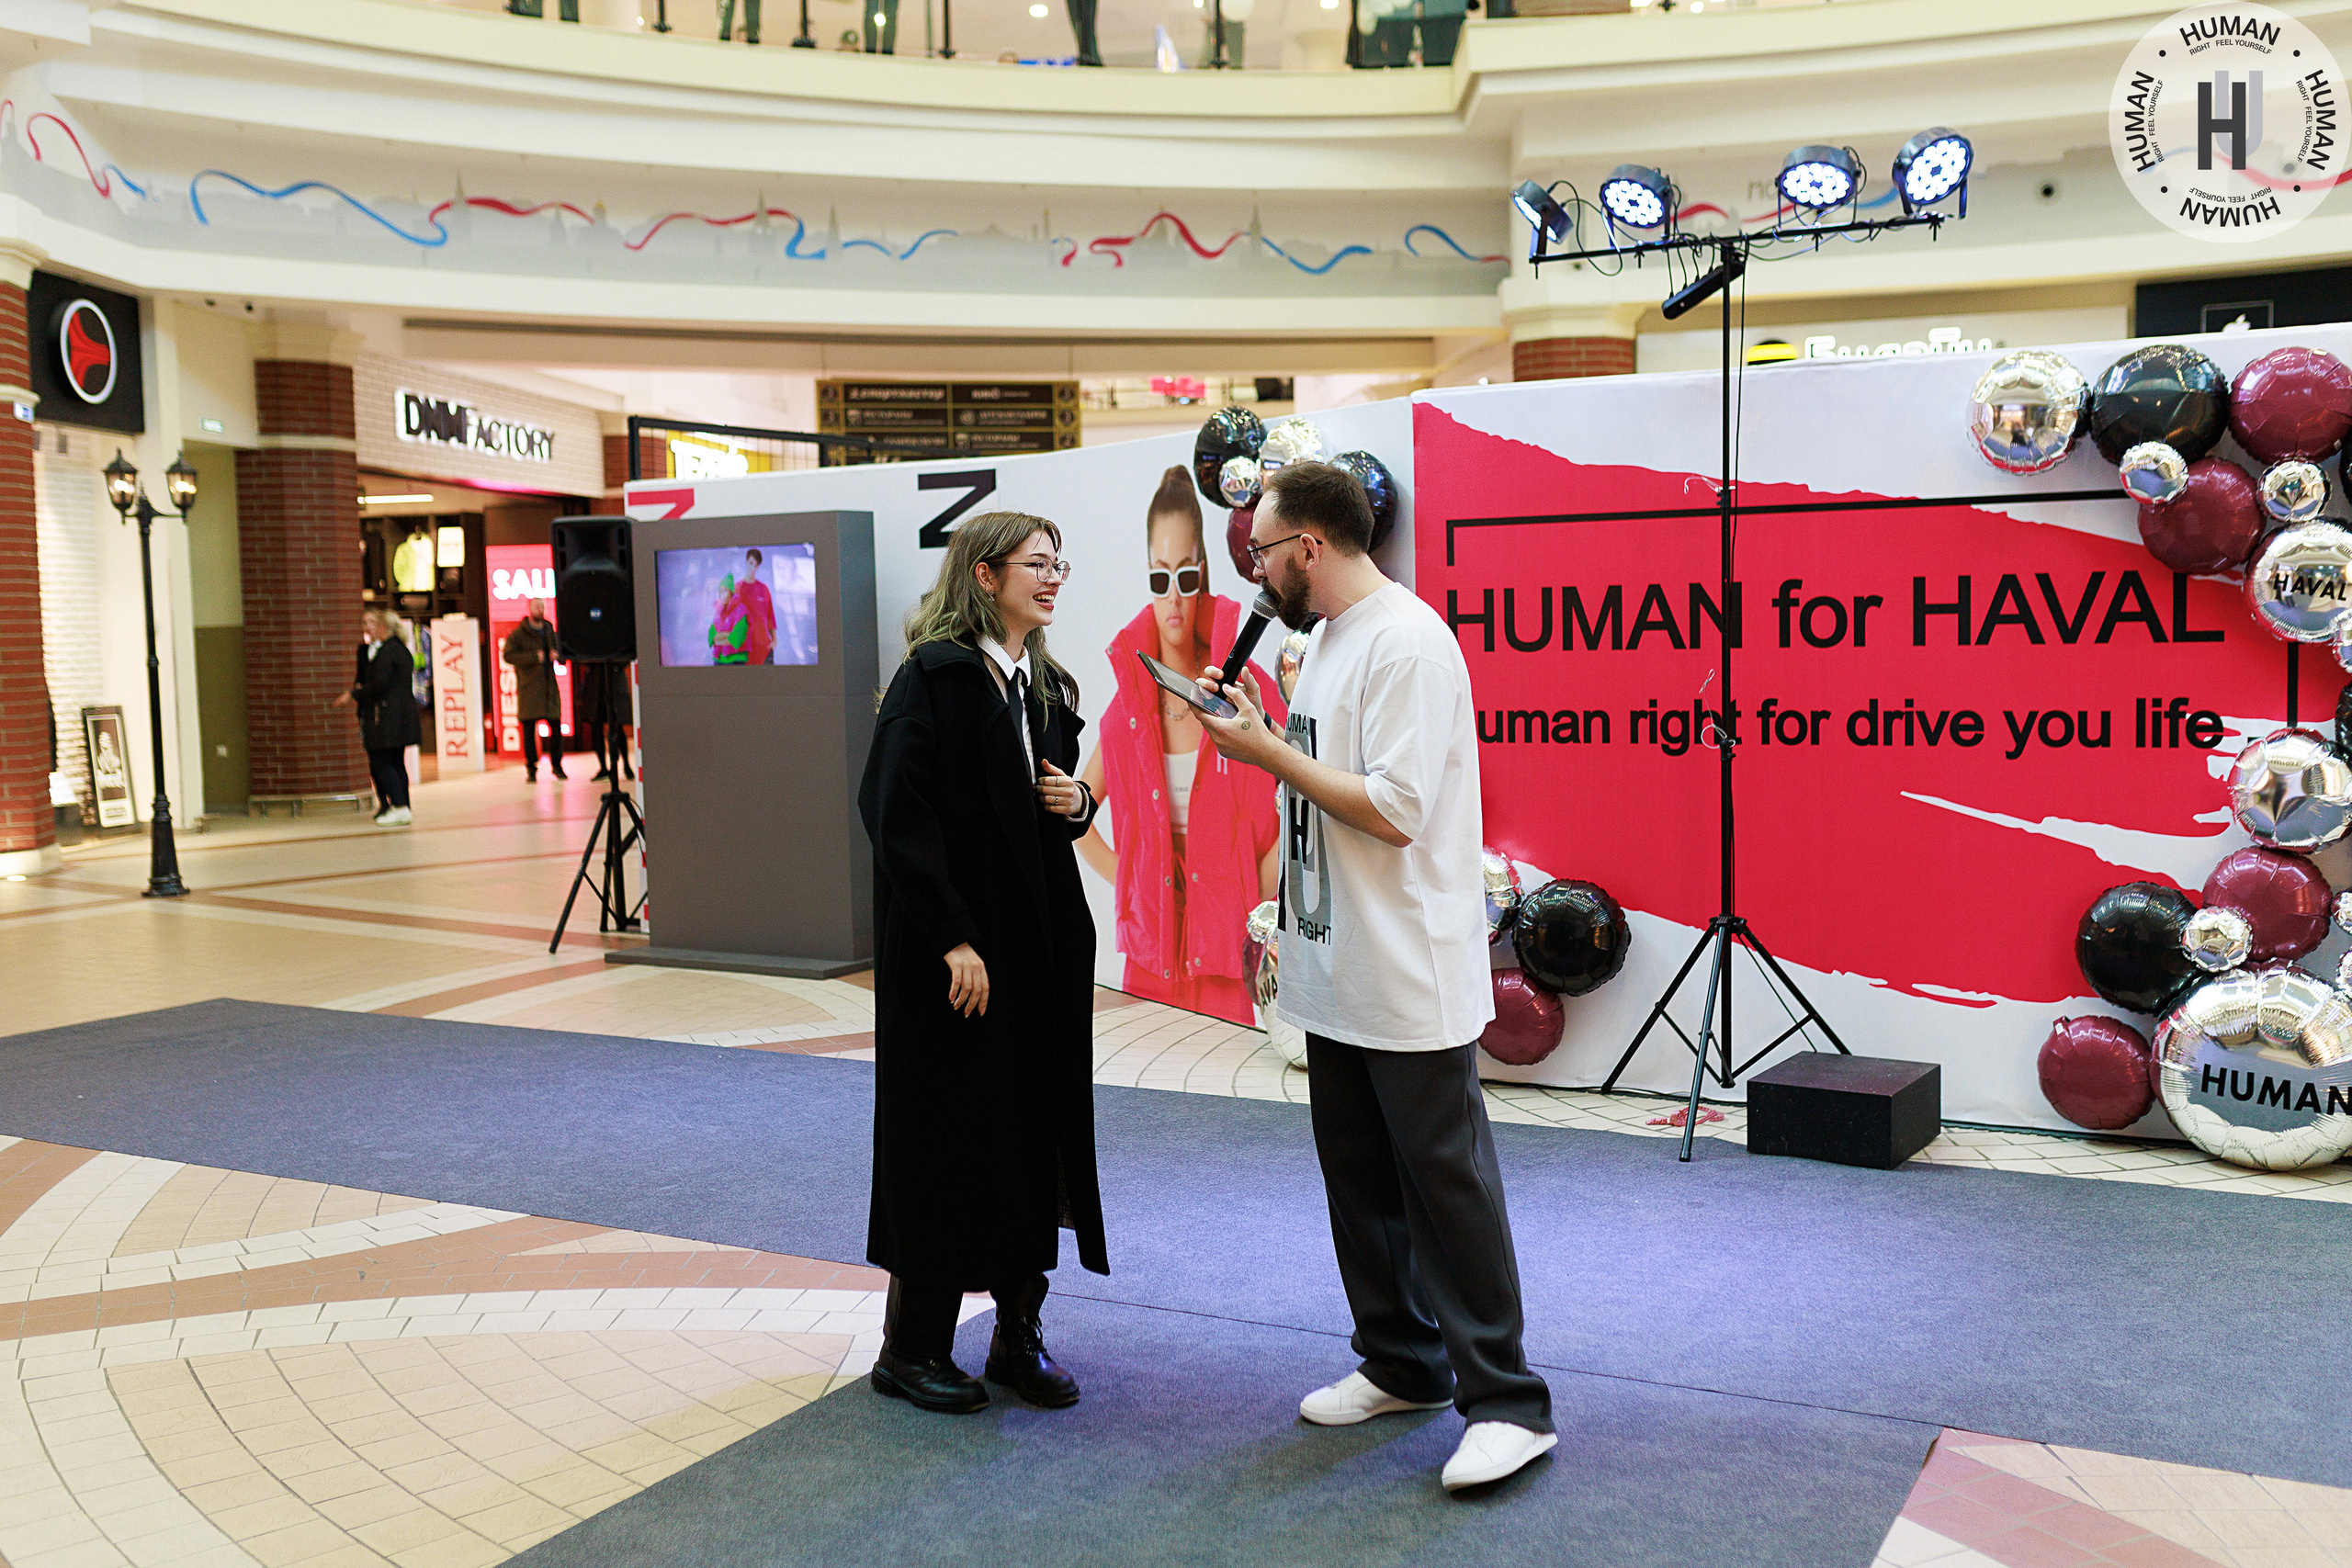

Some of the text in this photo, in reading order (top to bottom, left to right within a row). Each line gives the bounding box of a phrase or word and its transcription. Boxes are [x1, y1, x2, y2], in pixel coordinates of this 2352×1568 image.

[1446, 570, 2225, 653] HUMAN for HAVAL
[2273, 573, 2347, 602] HAVAL
[440, 634, 469, 760] REPLAY
[497, 637, 521, 752] DIES
[1286, 712, 1311, 737] UMA
[1477, 709, 1611, 745] uman
[1756, 698, 1831, 746] for
[1845, 698, 1985, 747] drive
[2003, 708, 2112, 760] you
[2134, 697, 2224, 750] life
[2199, 1063, 2352, 1116] HUMAN
